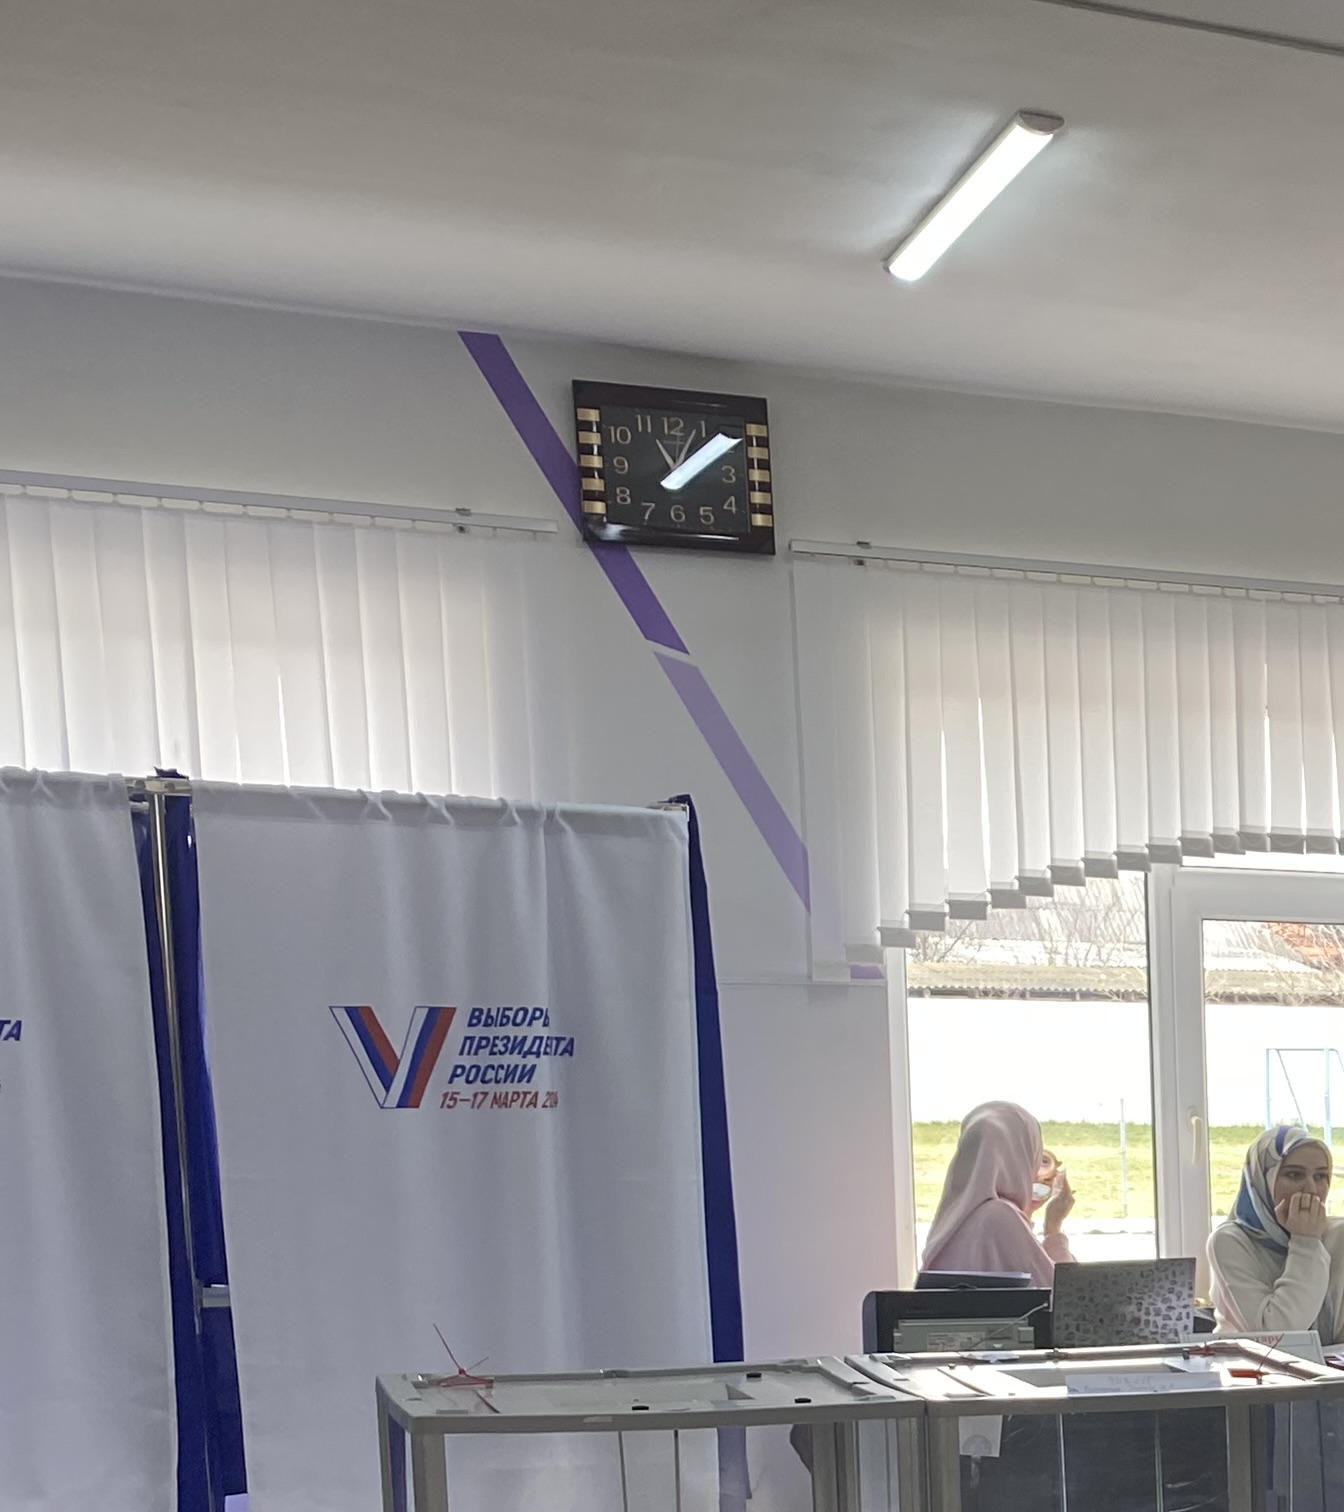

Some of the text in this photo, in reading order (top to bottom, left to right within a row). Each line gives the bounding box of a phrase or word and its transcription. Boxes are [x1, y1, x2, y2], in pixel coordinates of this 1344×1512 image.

[635, 415, 652, 433] 11
[661, 417, 684, 436] 12
[699, 420, 707, 438] 1
[610, 426, 632, 445] 10
[613, 457, 629, 475] 9
[722, 466, 737, 483] 3
[616, 487, 632, 505] 8
[640, 502, 656, 520] 7
[670, 505, 685, 522] 6
[723, 496, 736, 515] 4
[699, 507, 715, 525] 5
[448, 1064, 537, 1085] РОССИИ
[490, 1091, 539, 1109] МАРТА
